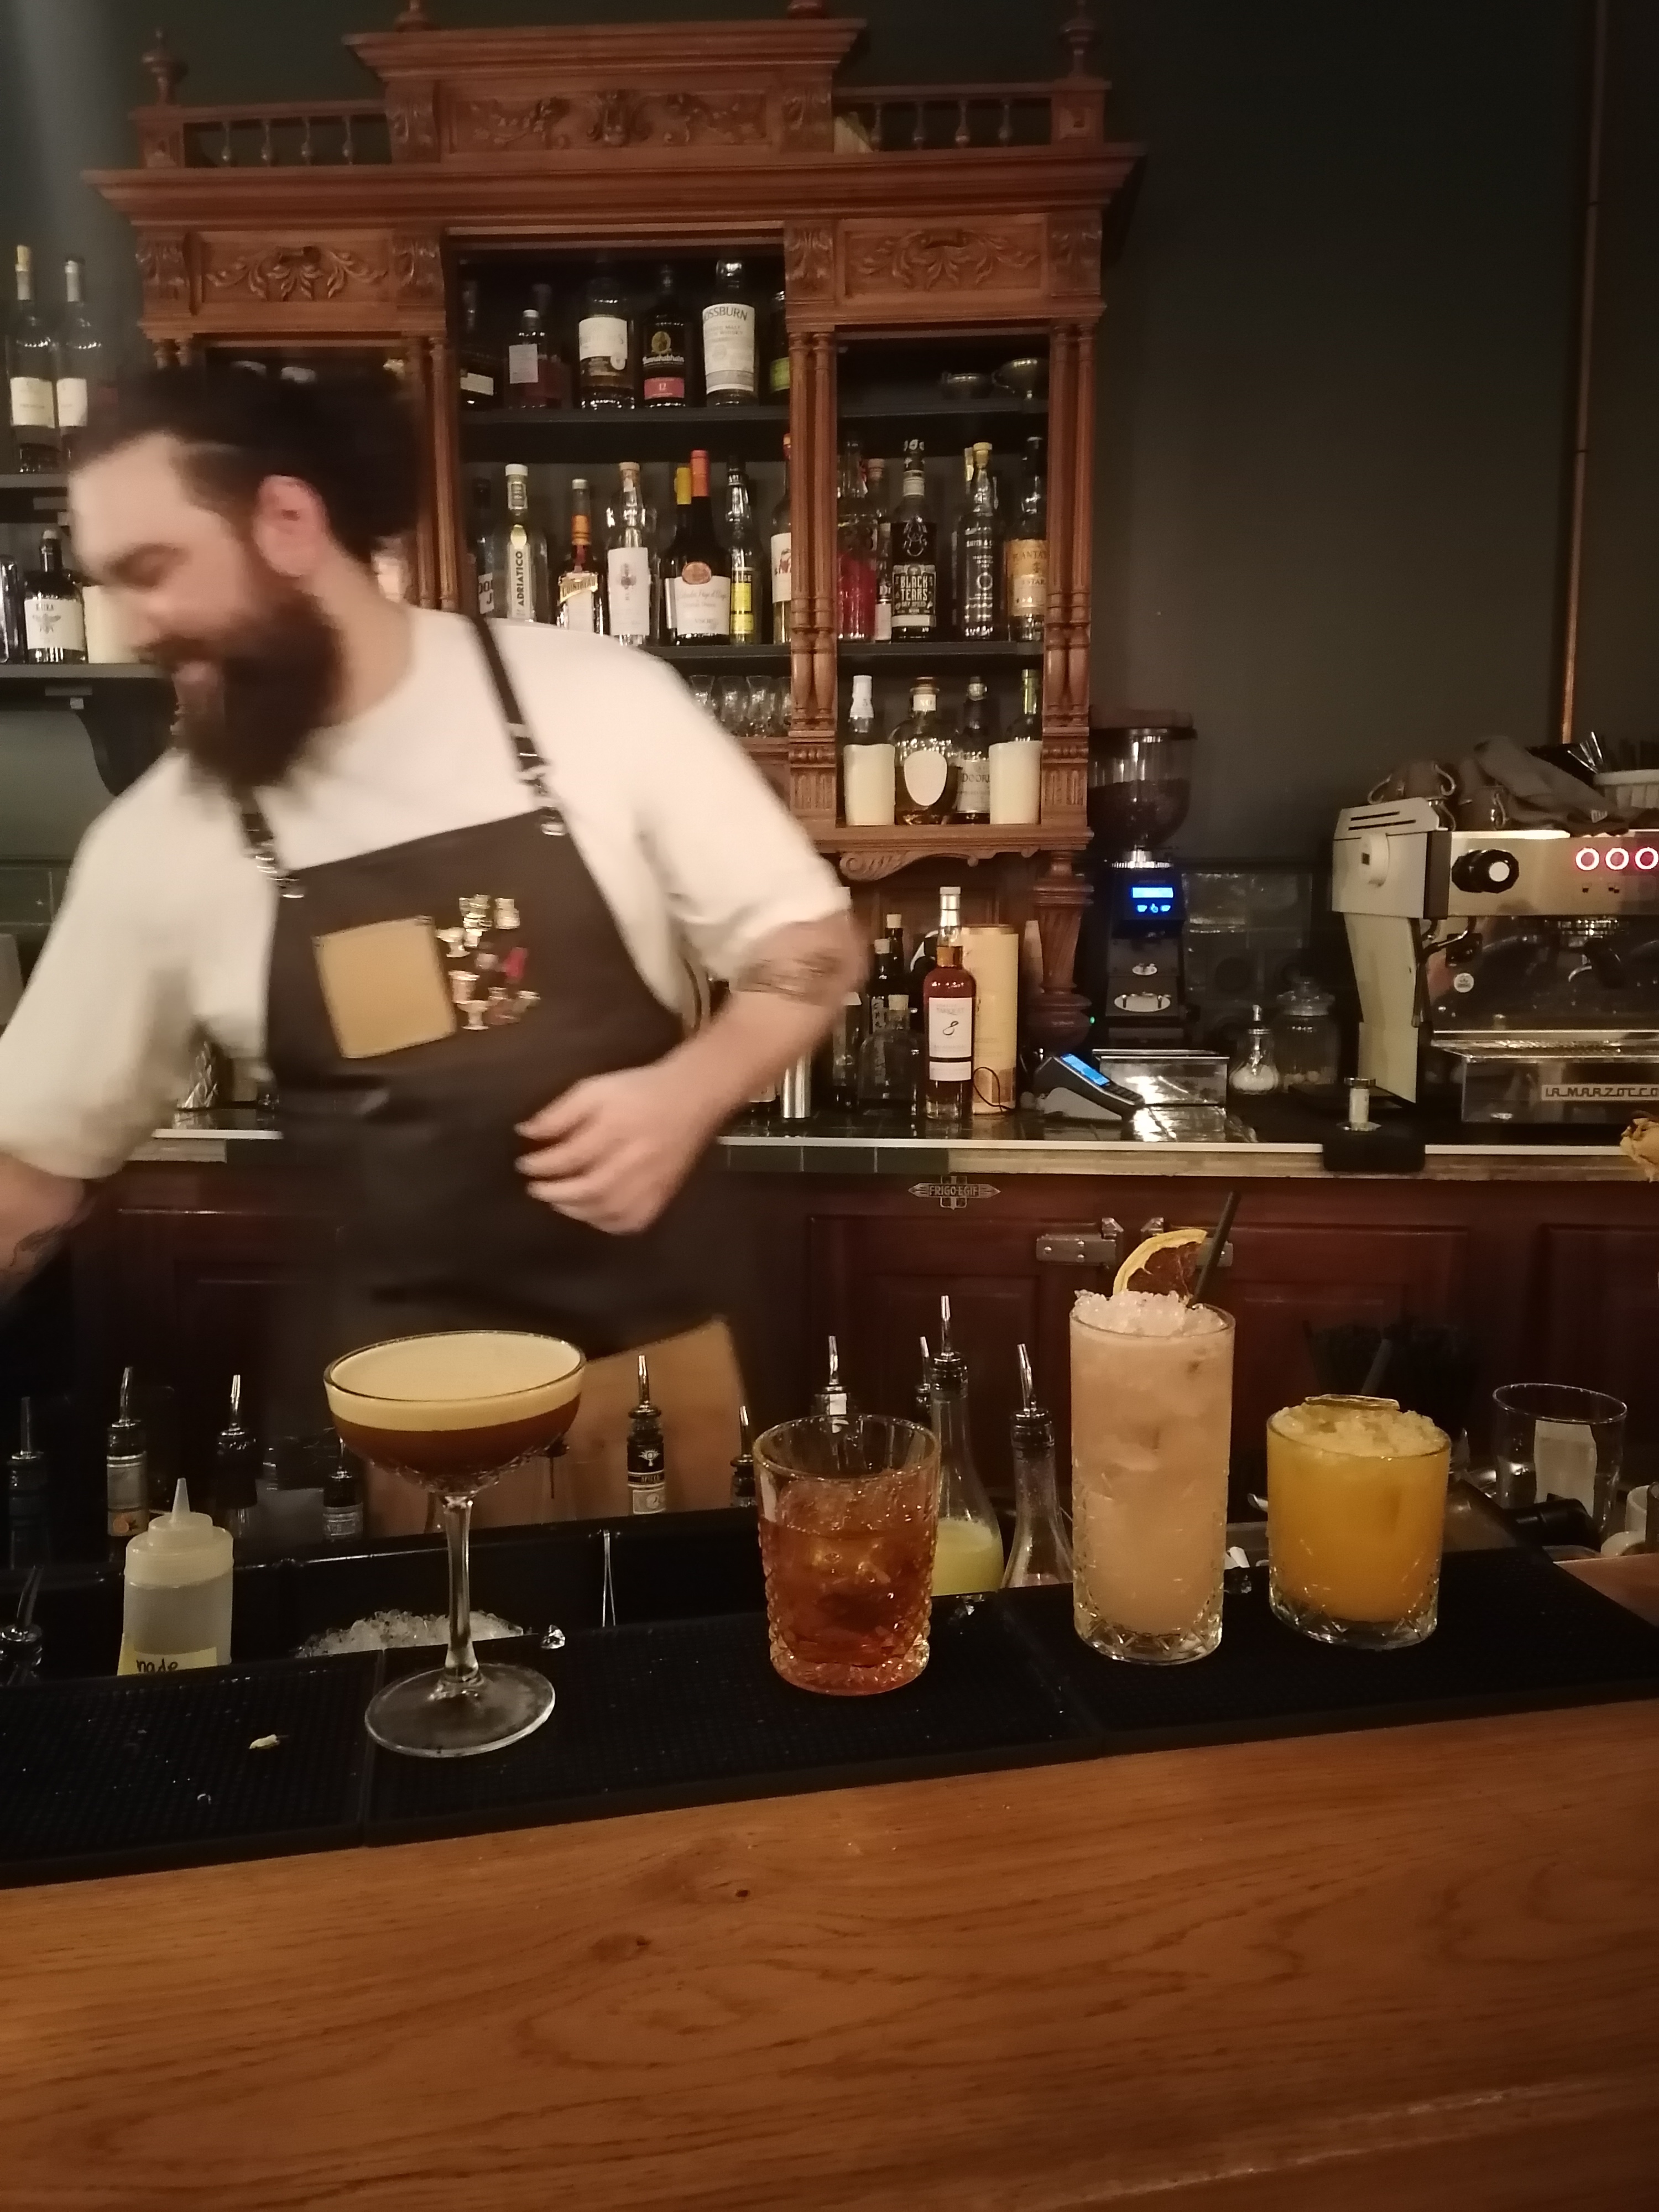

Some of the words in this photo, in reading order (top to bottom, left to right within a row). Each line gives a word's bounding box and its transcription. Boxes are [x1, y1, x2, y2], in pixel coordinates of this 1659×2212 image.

[703, 306, 748, 324] OSSBURN
[515, 551, 524, 606] ADRIATICO
[900, 576, 927, 588] BLACK
[901, 588, 927, 601] TEARS
[942, 1020, 959, 1036] 8
[1546, 1087, 1559, 1097] LA
[1567, 1087, 1658, 1097] MARZOCCO
